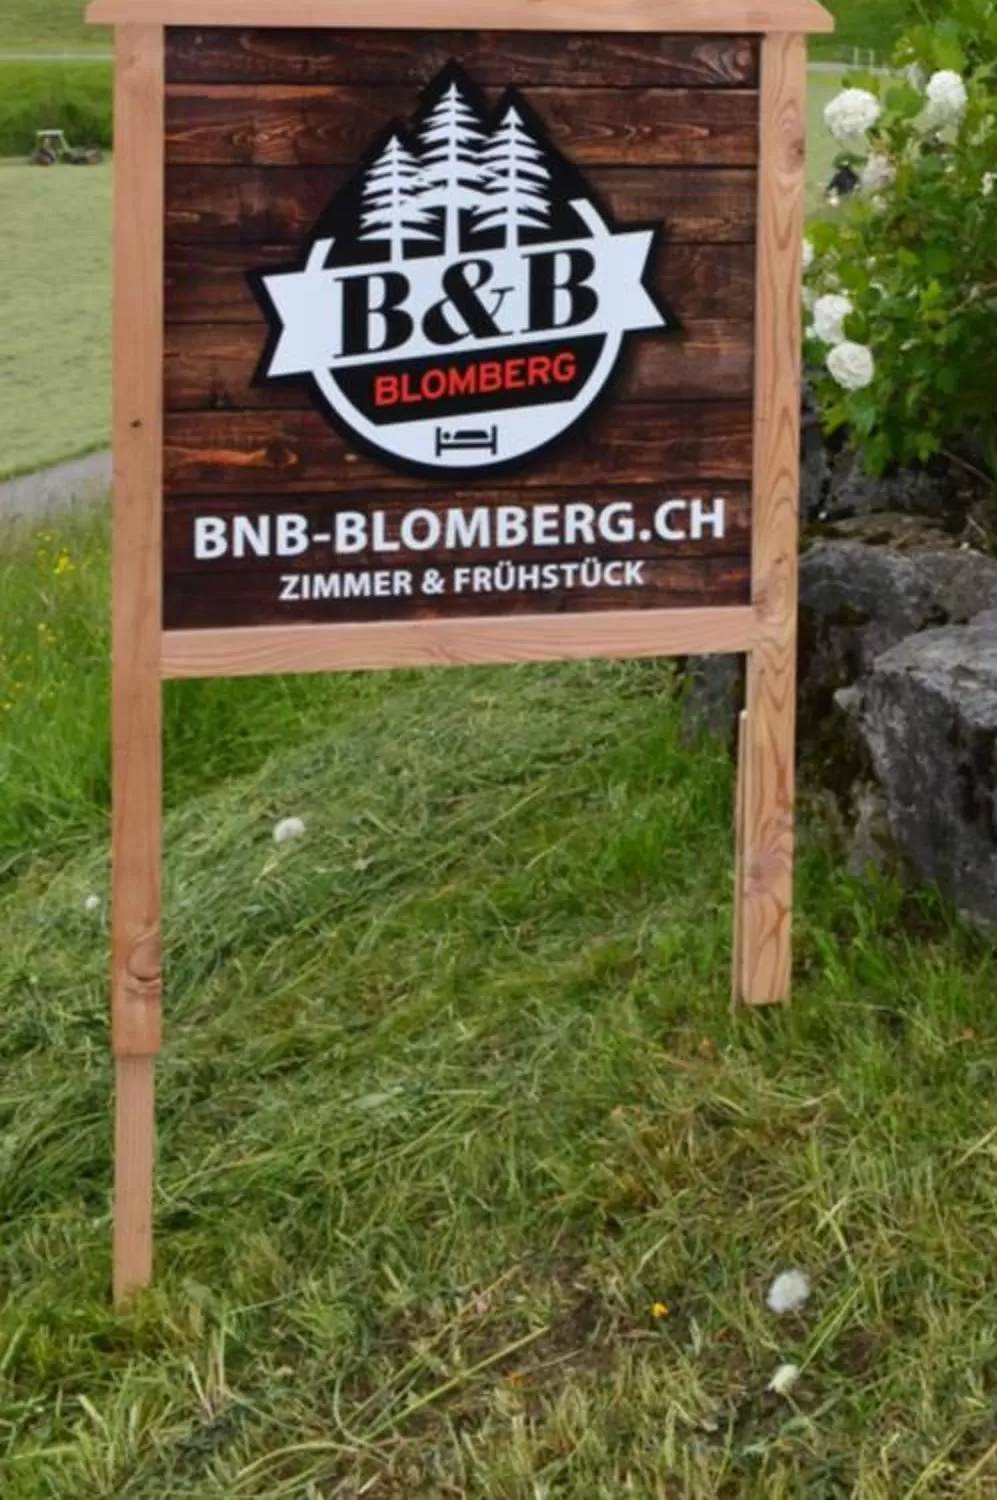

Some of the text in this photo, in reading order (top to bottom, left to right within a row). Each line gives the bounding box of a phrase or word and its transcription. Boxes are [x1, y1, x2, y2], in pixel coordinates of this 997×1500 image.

[333, 248, 600, 359] B&B
[373, 353, 577, 406] BLOMBERG
[193, 499, 726, 560] BNB-BLOMBERG.CH
[279, 559, 645, 601] ZIMMER & FRÜHSTÜCK
